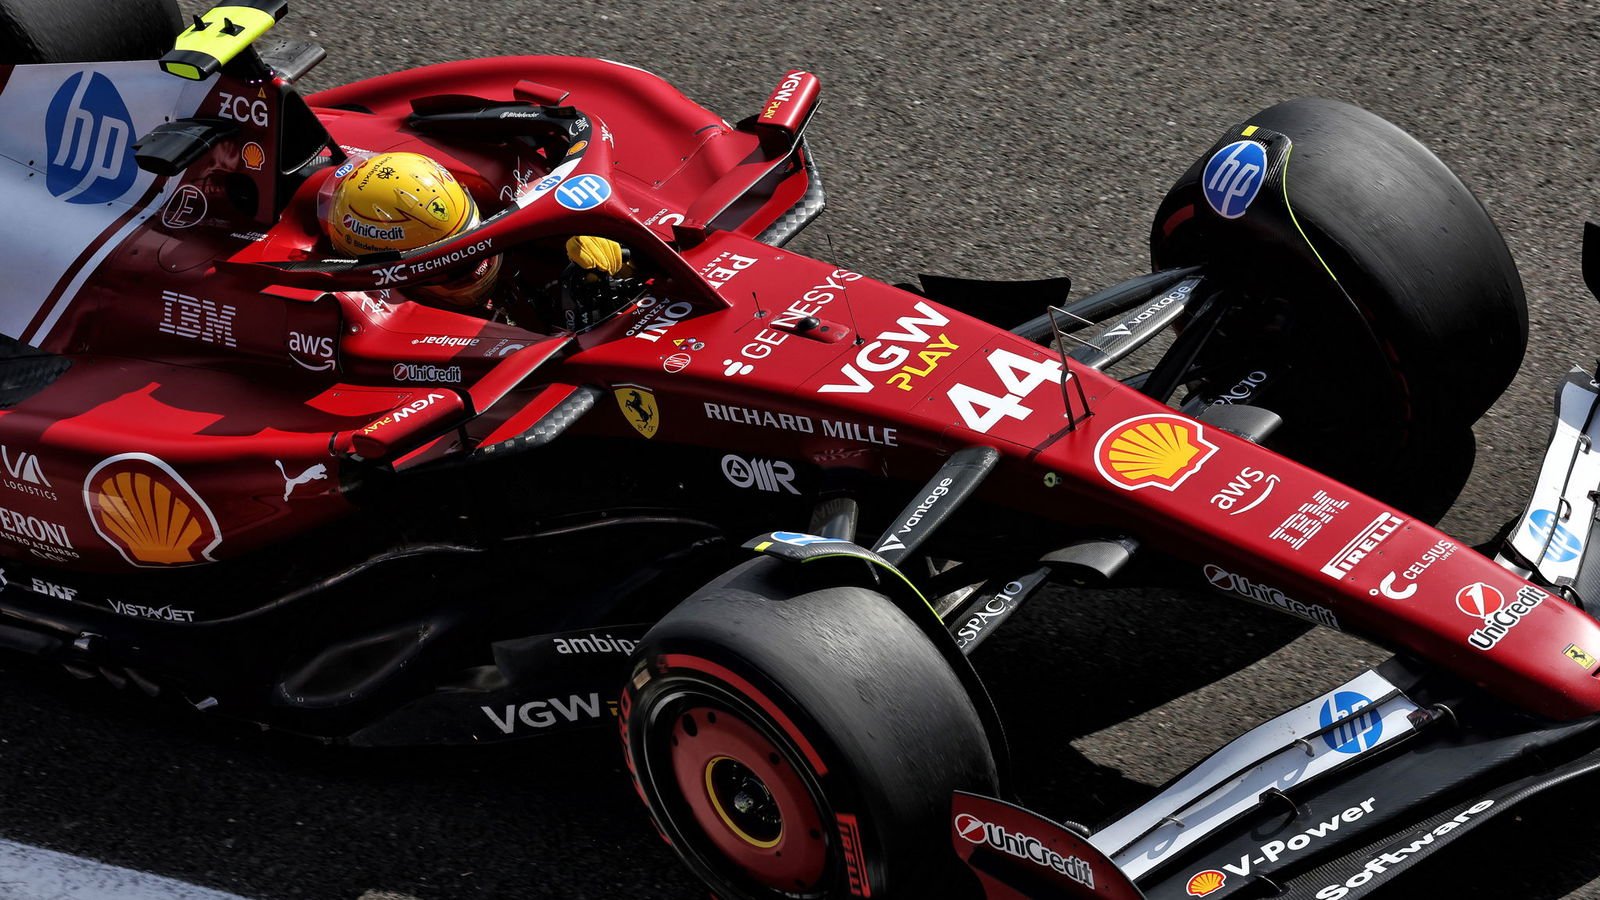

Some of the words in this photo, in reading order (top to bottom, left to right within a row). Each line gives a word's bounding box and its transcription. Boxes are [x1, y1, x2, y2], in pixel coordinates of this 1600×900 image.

[779, 71, 806, 102] VGW
[218, 92, 268, 127] ZCG
[763, 101, 782, 119] PLAY
[53, 71, 129, 199] hp
[559, 176, 605, 206] hp
[1208, 141, 1259, 216] hp
[351, 222, 404, 240] UniCredit
[372, 264, 409, 286] DXC
[409, 238, 494, 274] TECHNOLOGY
[159, 290, 236, 347] IBM
[626, 298, 670, 336] AZZURRO
[741, 269, 864, 359] GENESYS
[1128, 285, 1191, 326] vantage
[289, 331, 333, 358] aws
[422, 335, 480, 347] ambipar
[817, 301, 950, 393] VGW
[886, 333, 959, 391] PLAY
[407, 364, 461, 383] UniCredit
[946, 348, 1073, 434] 44
[365, 417, 392, 435] PLAY
[393, 392, 444, 422] VGW
[704, 402, 814, 433] RICHARD
[822, 420, 898, 447] MILLE
[1, 445, 52, 488] VA
[1210, 466, 1264, 510] aws
[3, 479, 57, 501] LOGISTICS
[899, 477, 953, 534] vantage
[1268, 489, 1350, 551] IBM
[33, 541, 80, 558] AZZURRO
[1320, 511, 1405, 581] PIRELLI
[1402, 540, 1453, 580] CELSIUS
[32, 577, 78, 601] SKF
[1231, 573, 1340, 630] UniCredit
[1468, 584, 1548, 652] UniCredit
[553, 634, 640, 656] ambip
[480, 693, 600, 734] VGW
[835, 812, 871, 898] PIRELLI
[985, 823, 1096, 890] UniCredit
[1223, 796, 1377, 877] V-Power
[1316, 800, 1495, 900] Software
